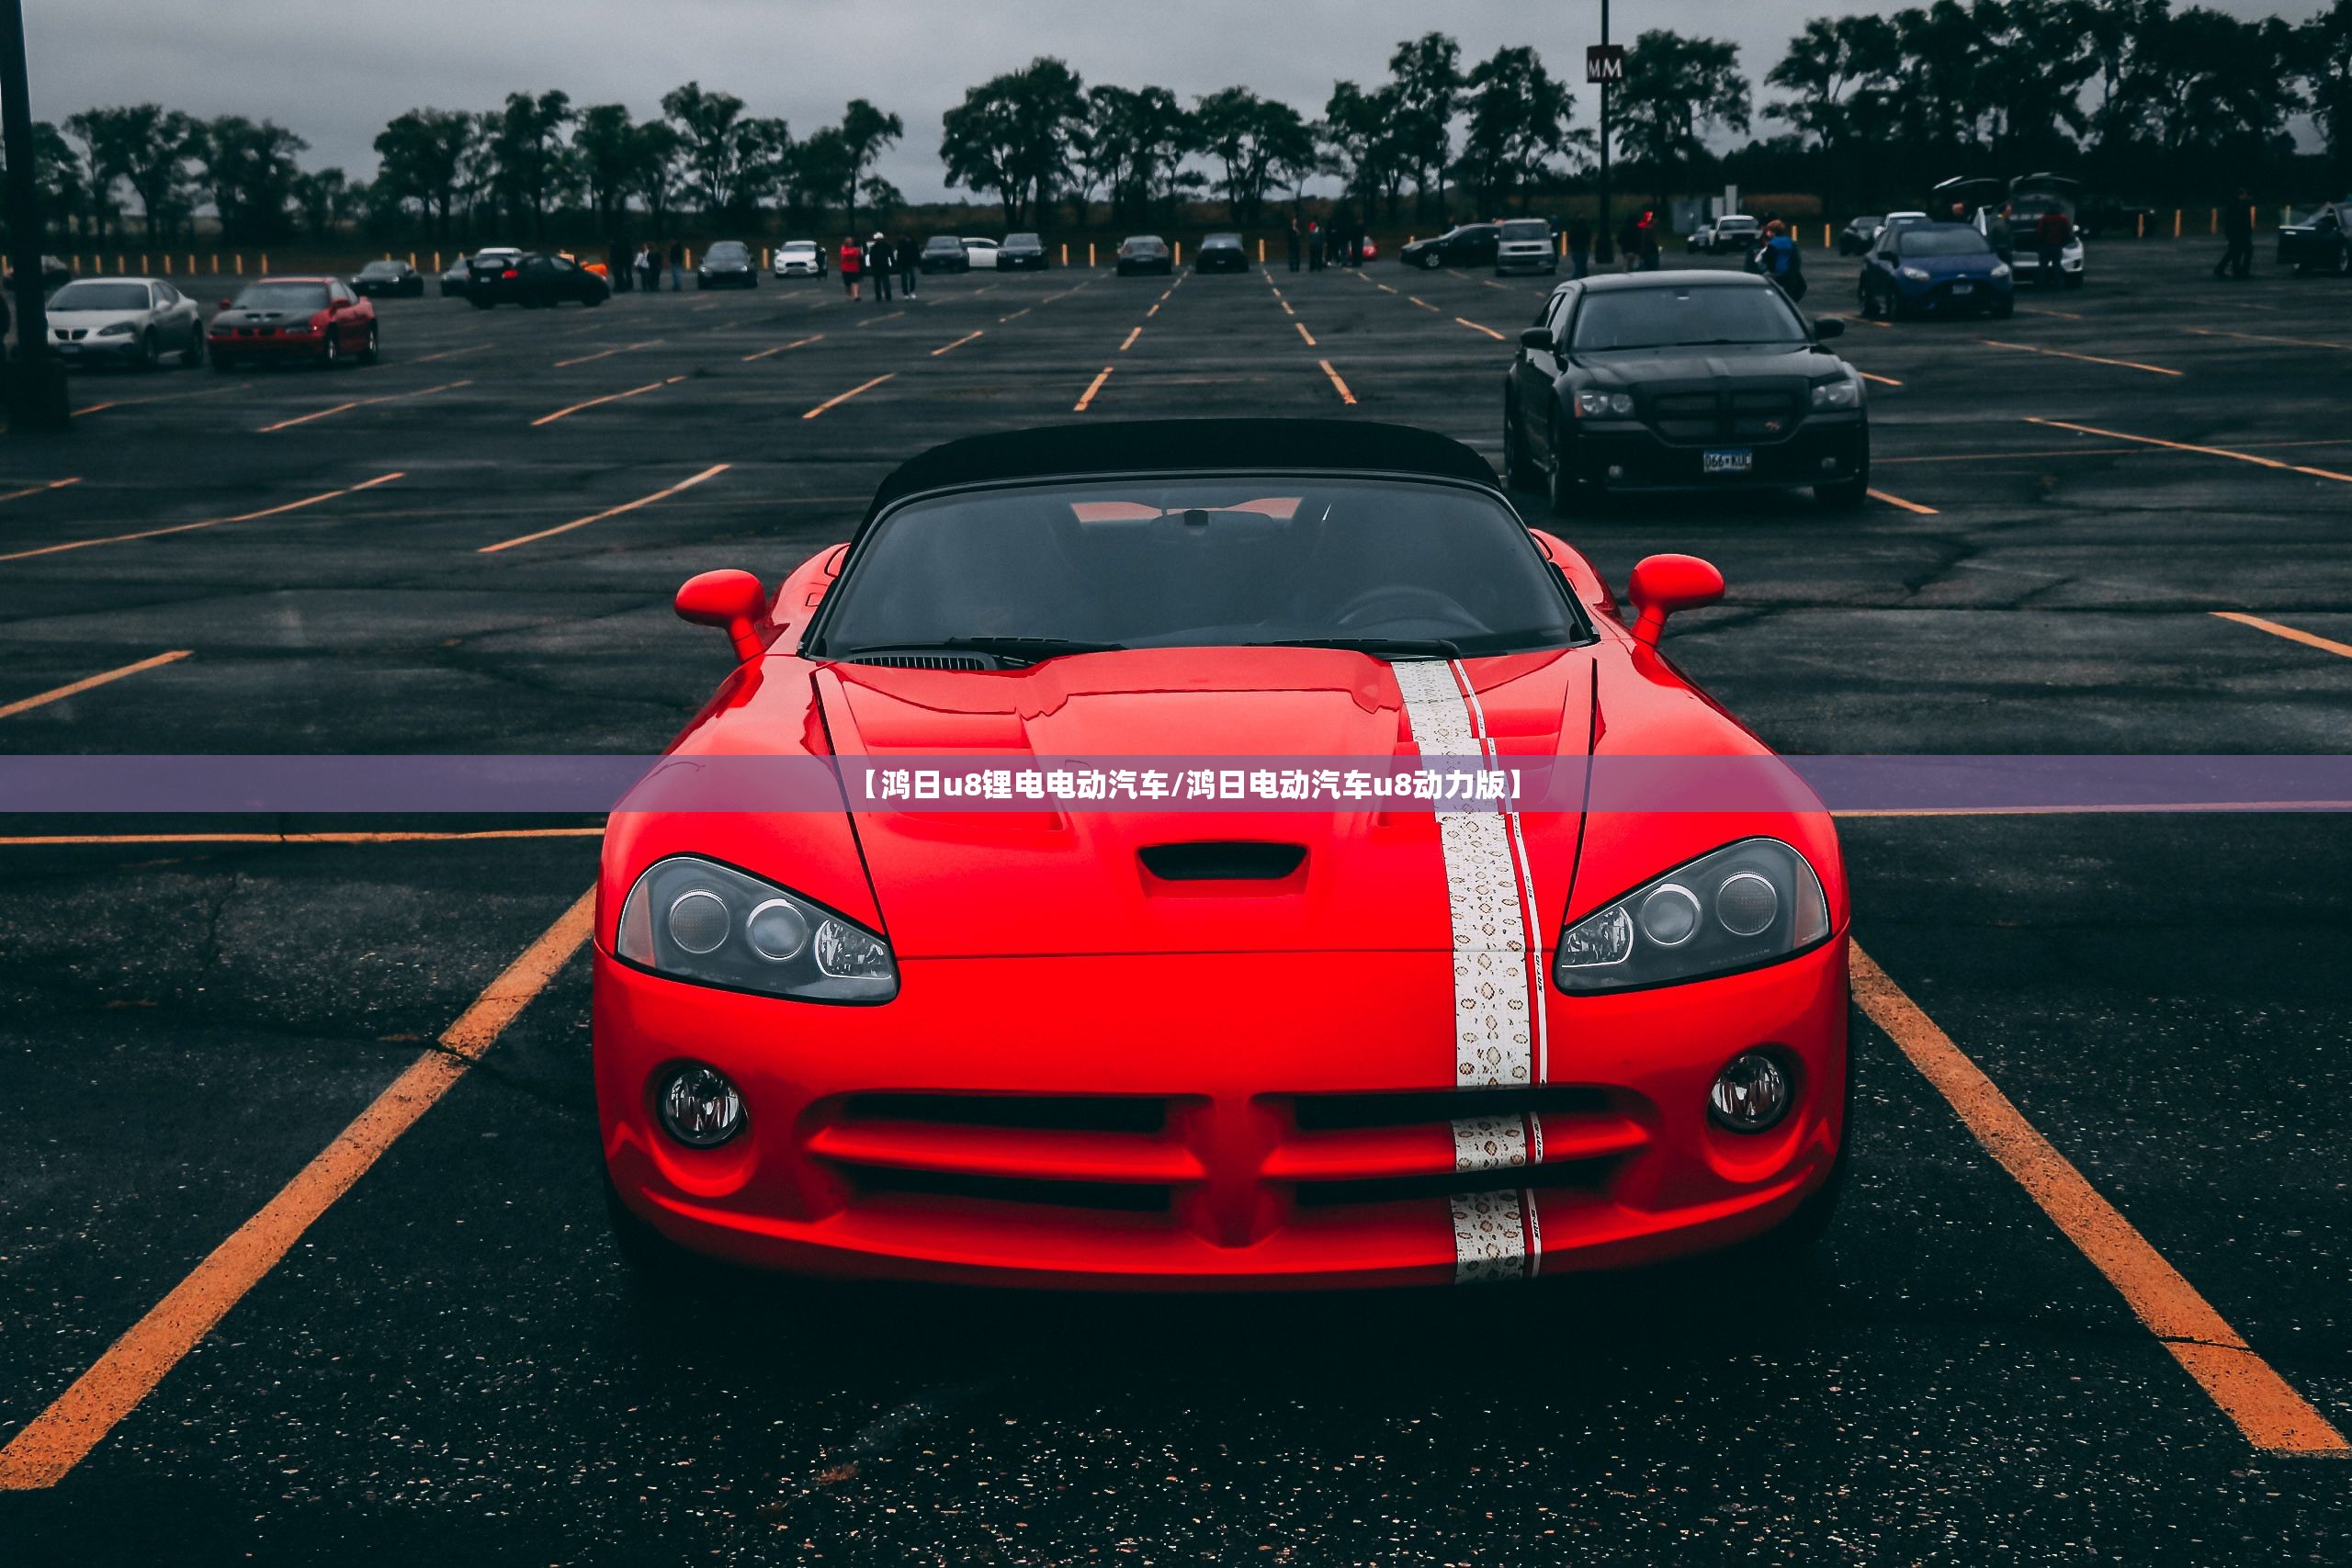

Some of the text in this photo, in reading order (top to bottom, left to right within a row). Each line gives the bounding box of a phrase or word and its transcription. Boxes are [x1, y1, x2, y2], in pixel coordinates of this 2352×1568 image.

[1589, 58, 1623, 78] MM
[1705, 455, 1724, 468] 066
[1534, 954, 1544, 993] SRT-10
